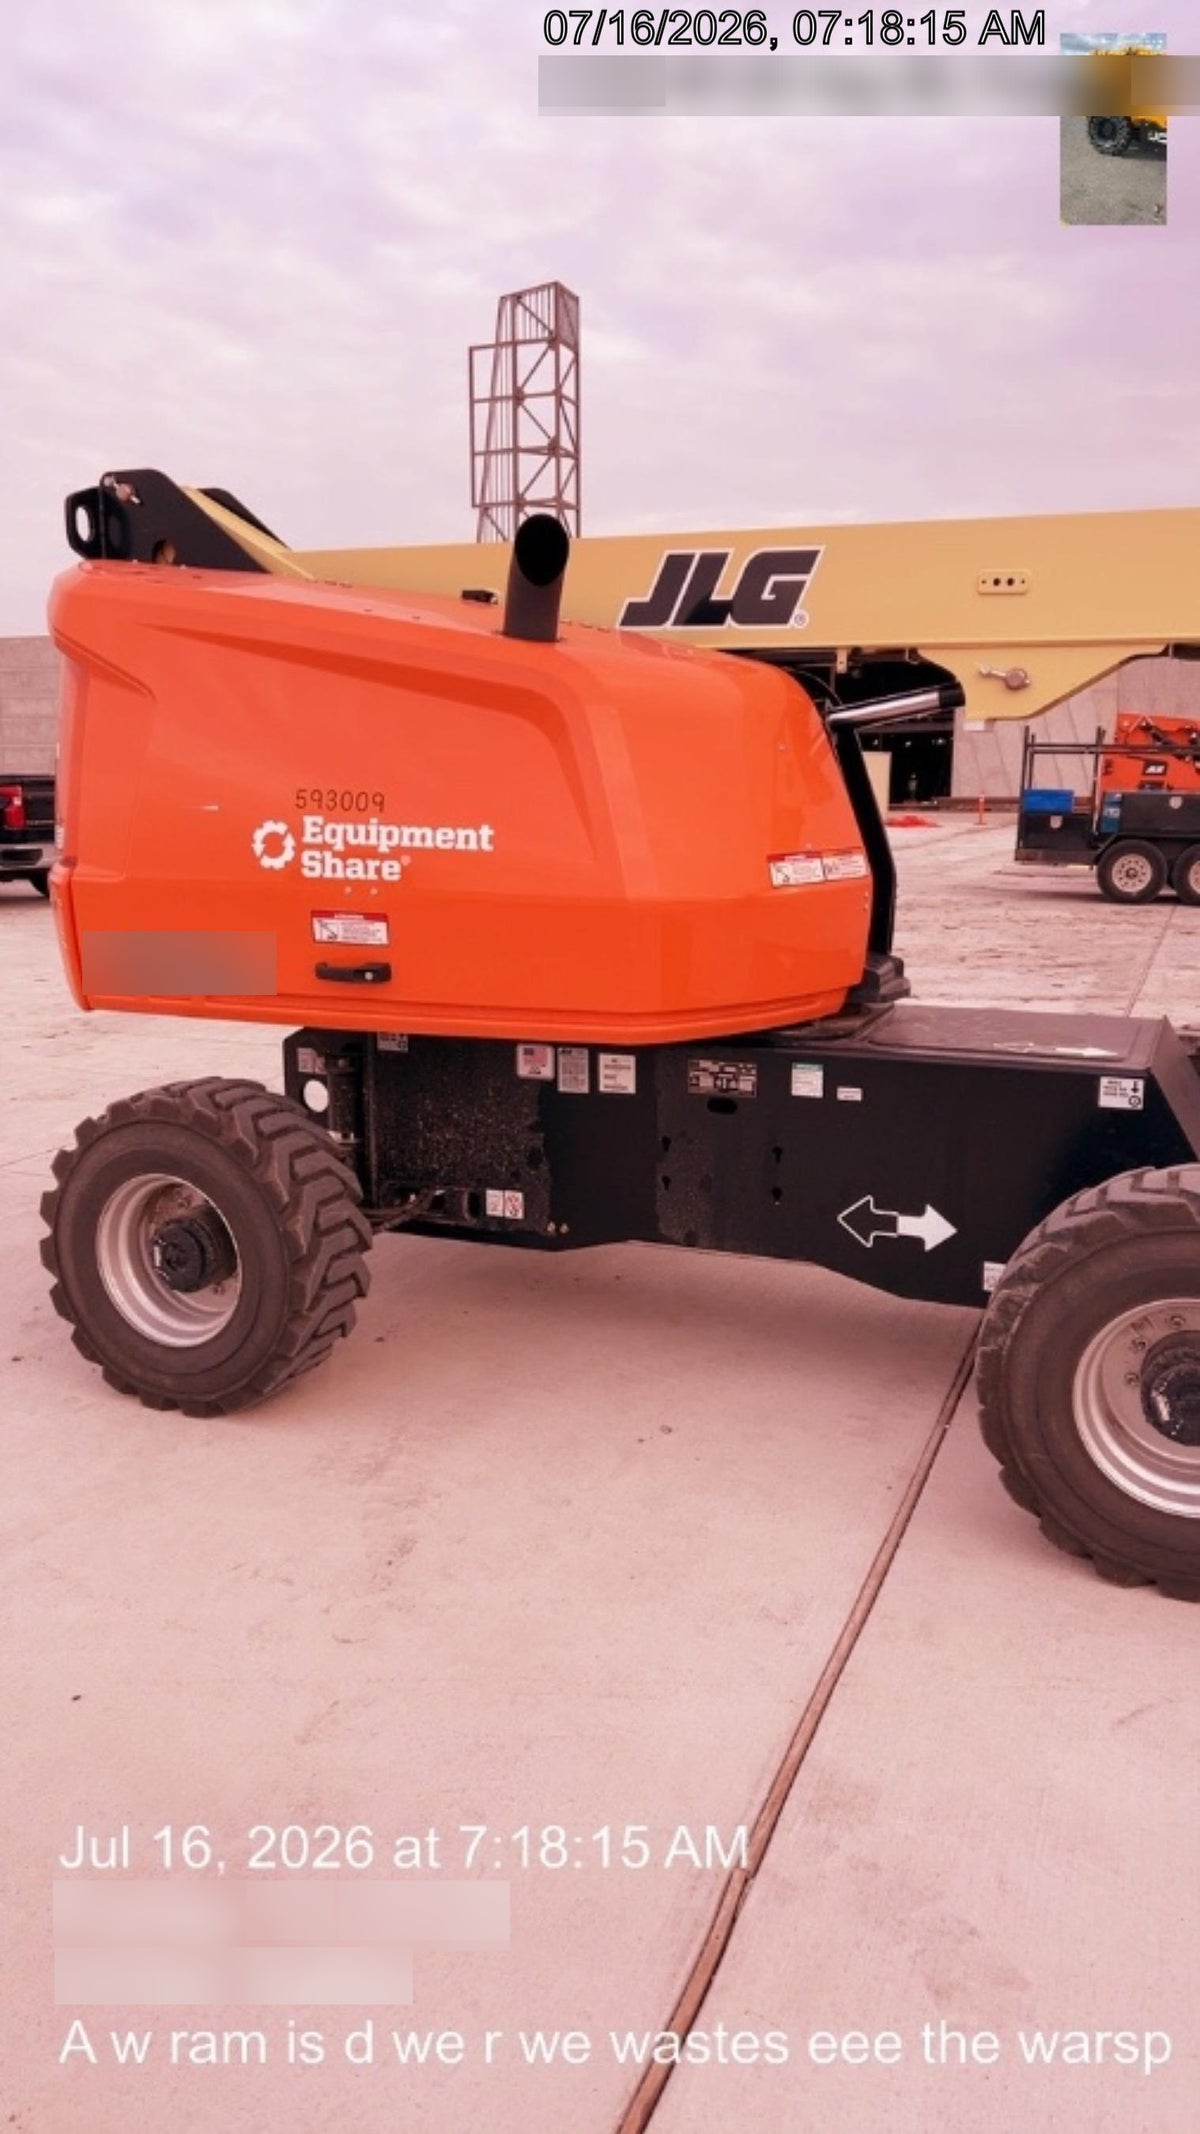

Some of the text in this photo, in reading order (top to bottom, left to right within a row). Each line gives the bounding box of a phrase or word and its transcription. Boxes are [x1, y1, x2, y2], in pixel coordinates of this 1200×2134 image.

[618, 546, 825, 629] JLG
[295, 789, 386, 813] 593009
[302, 814, 494, 853] Equipment
[301, 850, 402, 881] Share
